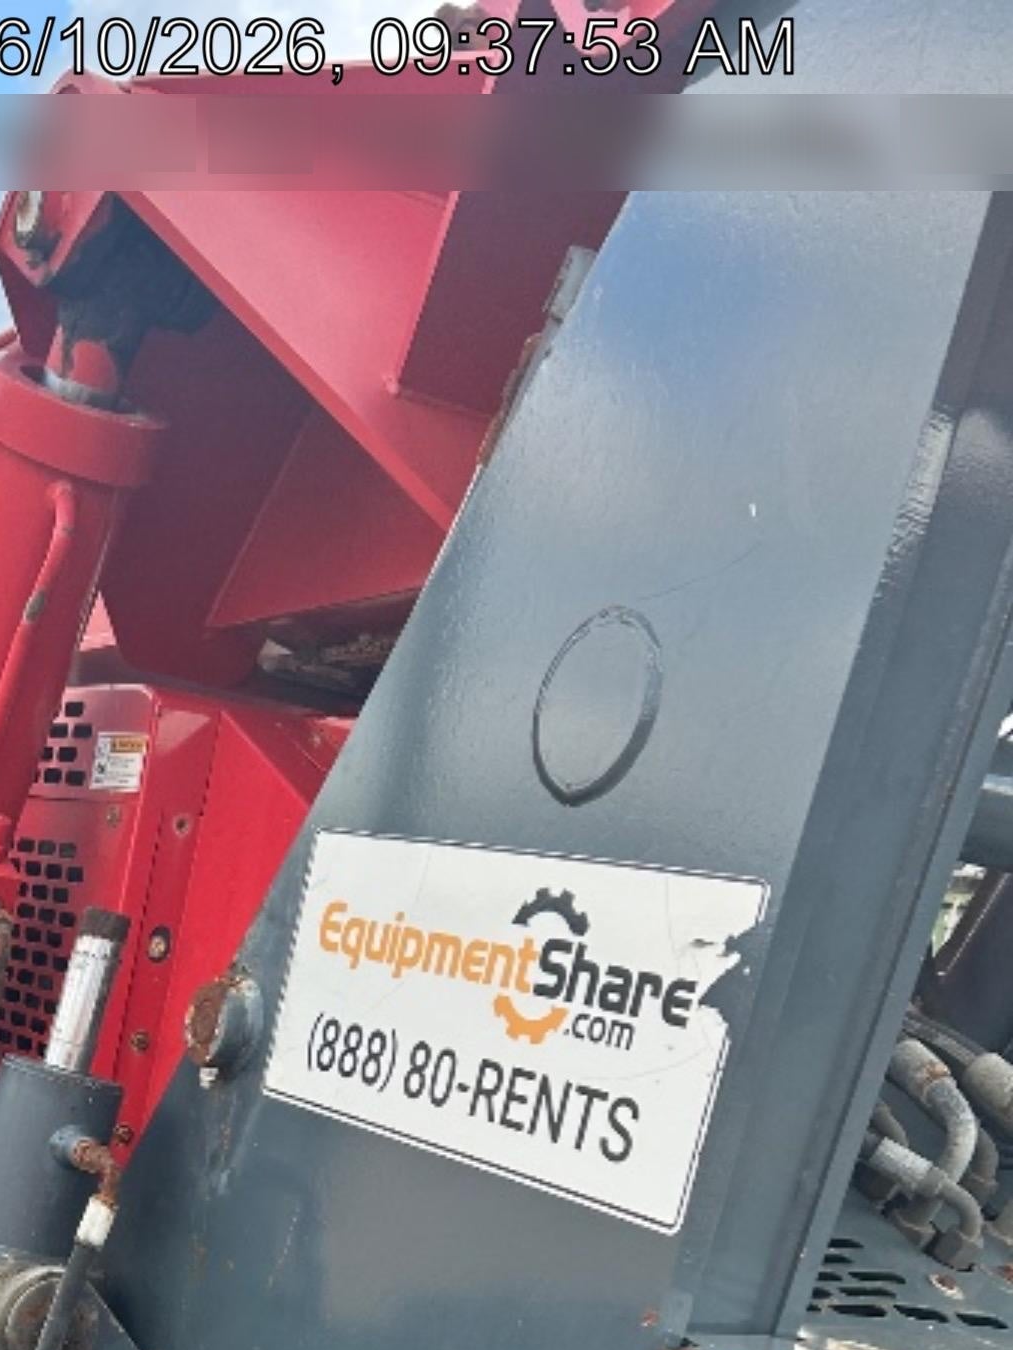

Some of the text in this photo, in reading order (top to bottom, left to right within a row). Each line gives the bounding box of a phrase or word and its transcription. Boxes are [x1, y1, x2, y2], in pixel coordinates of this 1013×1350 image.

[319, 899, 697, 1028] EquipmentShare
[307, 1011, 640, 1162] (888) 80-RENTS
[563, 1013, 635, 1051] .com
